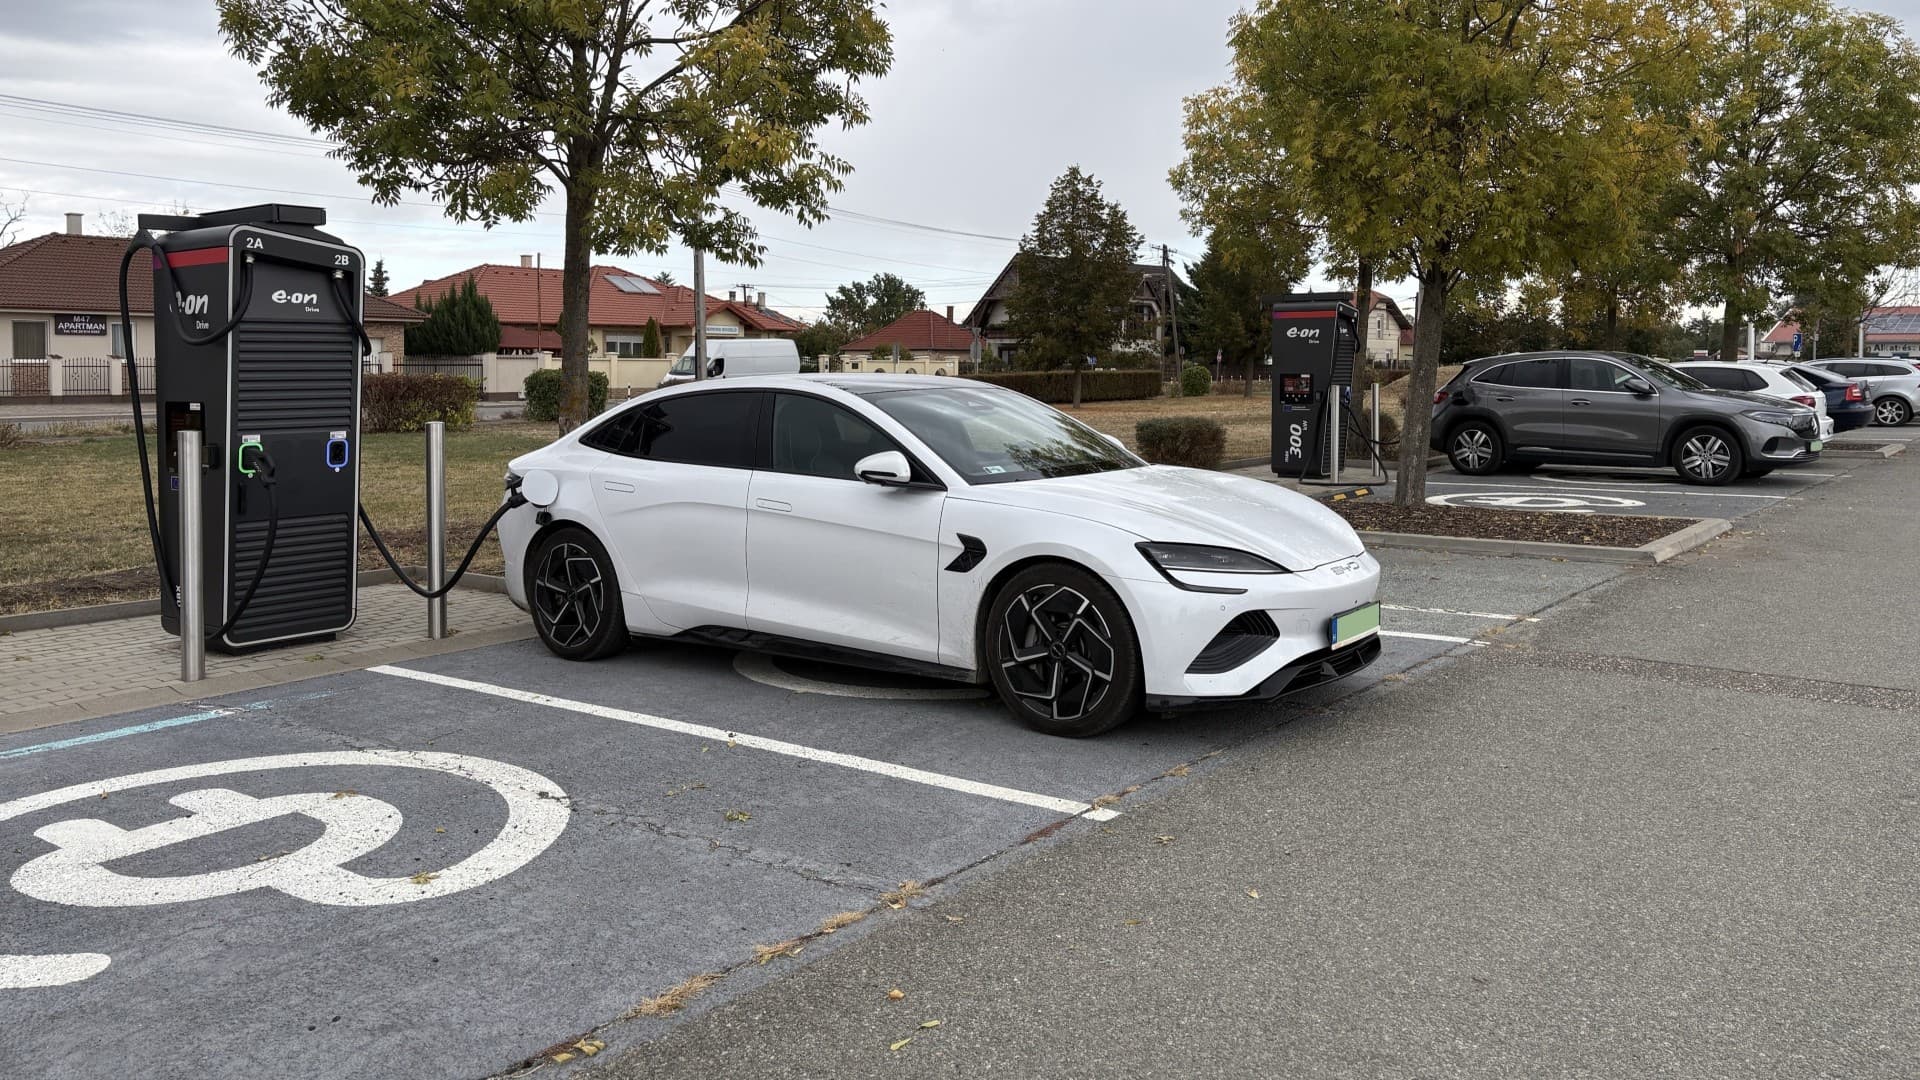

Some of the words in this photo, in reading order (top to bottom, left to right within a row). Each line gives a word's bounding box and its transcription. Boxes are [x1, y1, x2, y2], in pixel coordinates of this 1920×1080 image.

[246, 237, 264, 249] 2A
[334, 254, 349, 265] 2B
[73, 315, 91, 323] M47
[195, 319, 209, 329] Drive
[58, 322, 106, 330] APARTMAN
[1289, 423, 1302, 459] 300
[1330, 561, 1360, 576] BYD
